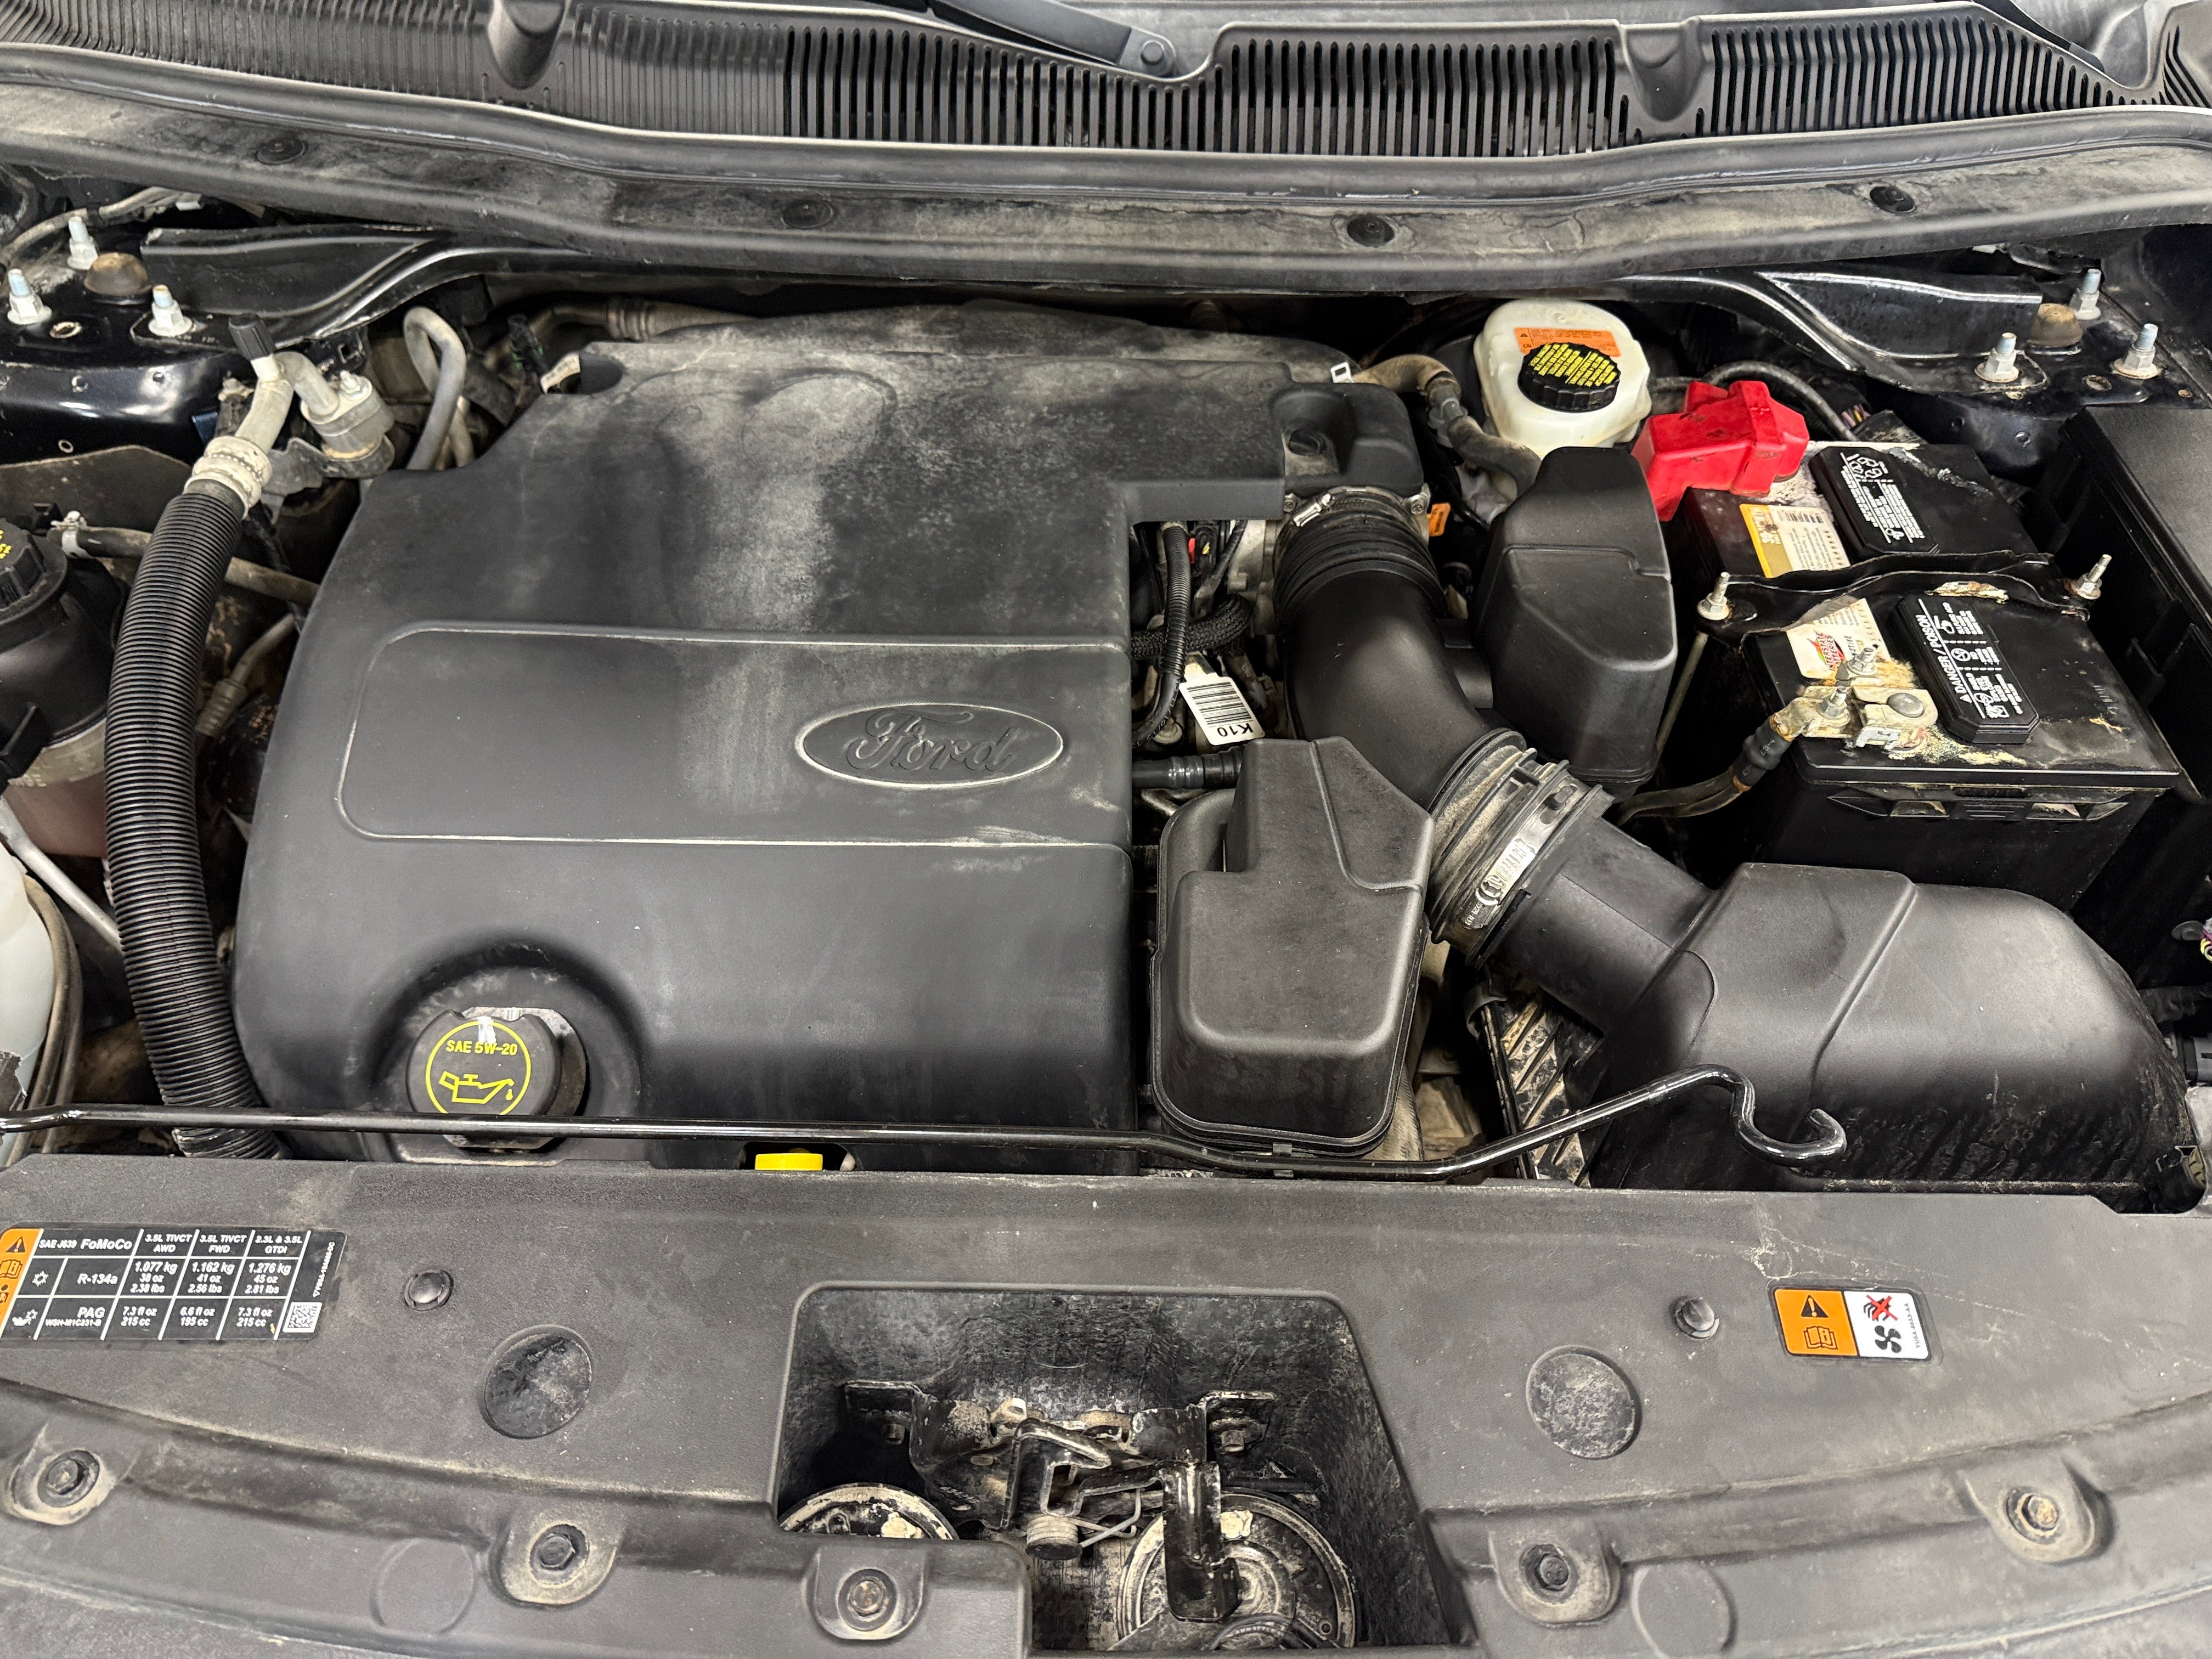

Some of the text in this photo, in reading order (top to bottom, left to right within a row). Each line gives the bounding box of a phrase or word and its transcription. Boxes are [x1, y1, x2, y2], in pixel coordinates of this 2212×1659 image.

[1915, 614, 1942, 648] POISON
[1816, 633, 1835, 670] INTERSTATE
[1938, 656, 1967, 693] DANGER
[1217, 723, 1254, 737] K10
[842, 710, 1022, 772] Ford
[446, 1040, 518, 1056] SAE 5W-20
[145, 1234, 163, 1243] 3.5L
[200, 1234, 218, 1243] 3.5L
[255, 1235, 273, 1243] 2.3L
[284, 1235, 302, 1244] 3.5L
[39, 1238, 133, 1250] SAE J639 FoMoCo
[153, 1244, 176, 1252] AWD
[208, 1245, 230, 1253] FWD
[264, 1245, 288, 1254] GTDI
[135, 1261, 178, 1275] 1.077 kg
[192, 1262, 235, 1275] 1.162 kg
[249, 1262, 291, 1276] 1.276 kg
[77, 1273, 118, 1284] R-134a
[139, 1273, 151, 1283] 38
[196, 1273, 208, 1283] 41
[254, 1274, 266, 1283] 45
[131, 1283, 165, 1293] 2.38 lbs
[188, 1283, 222, 1293] 2.56 lbs
[245, 1284, 279, 1294] 2.81 lbs
[77, 1307, 106, 1318] PAG
[122, 1306, 157, 1316] 7.3 fl oz
[180, 1306, 195, 1316] 6.6
[195, 1306, 203, 1316] fl
[238, 1307, 273, 1317] 7.3 fl oz
[121, 1317, 151, 1327] 215 cc
[180, 1317, 209, 1327] 195 cc
[236, 1318, 267, 1327] 215 cc
